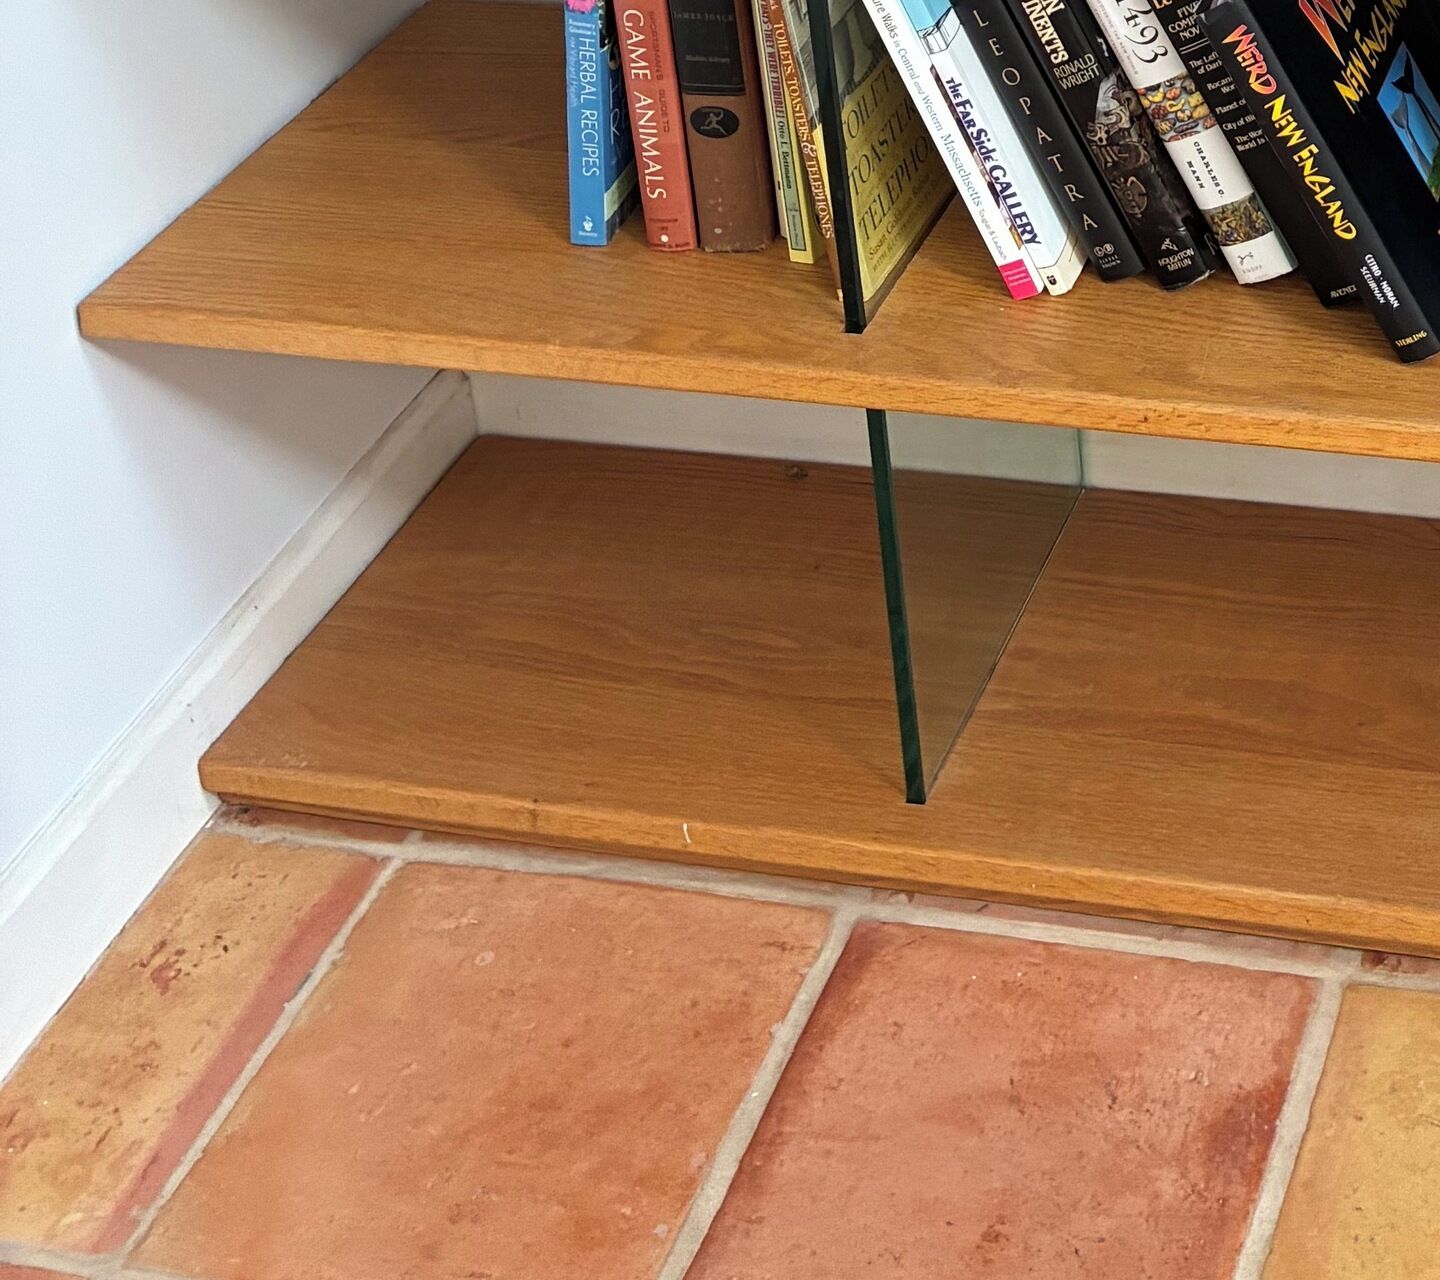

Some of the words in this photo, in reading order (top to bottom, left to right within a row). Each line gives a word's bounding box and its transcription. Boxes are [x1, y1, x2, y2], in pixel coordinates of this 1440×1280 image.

[579, 37, 596, 104] HERBAL
[623, 9, 650, 80] GAME
[1053, 54, 1095, 79] RONALD
[1058, 65, 1100, 91] WRIGHT
[581, 108, 599, 177] RECIPES
[634, 90, 666, 199] ANIMALS
[1222, 24, 1277, 94] WEIRD
[1265, 94, 1307, 147] NEW
[1293, 144, 1357, 240] ENGLAND
